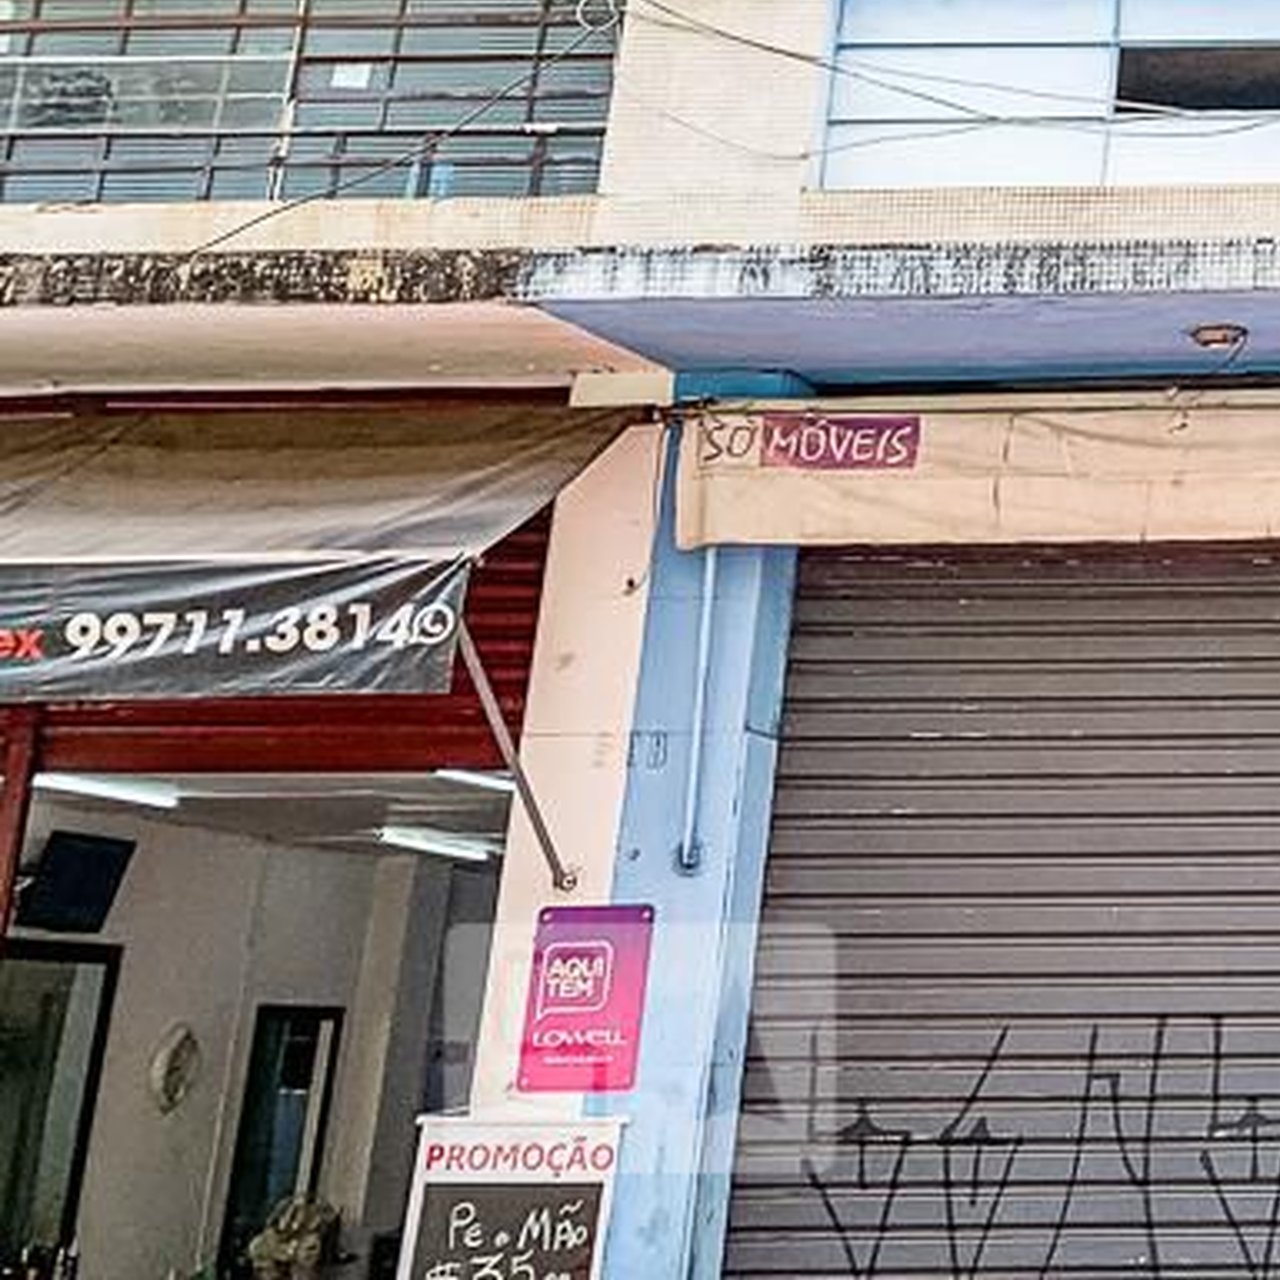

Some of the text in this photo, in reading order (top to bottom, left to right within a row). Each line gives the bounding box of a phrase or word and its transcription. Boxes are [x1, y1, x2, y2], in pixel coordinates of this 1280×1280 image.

[64, 602, 412, 661] 99711.3814
[547, 954, 604, 980] AQUI
[547, 979, 595, 999] TEM
[425, 1138, 615, 1177] PROMOÇÃO
